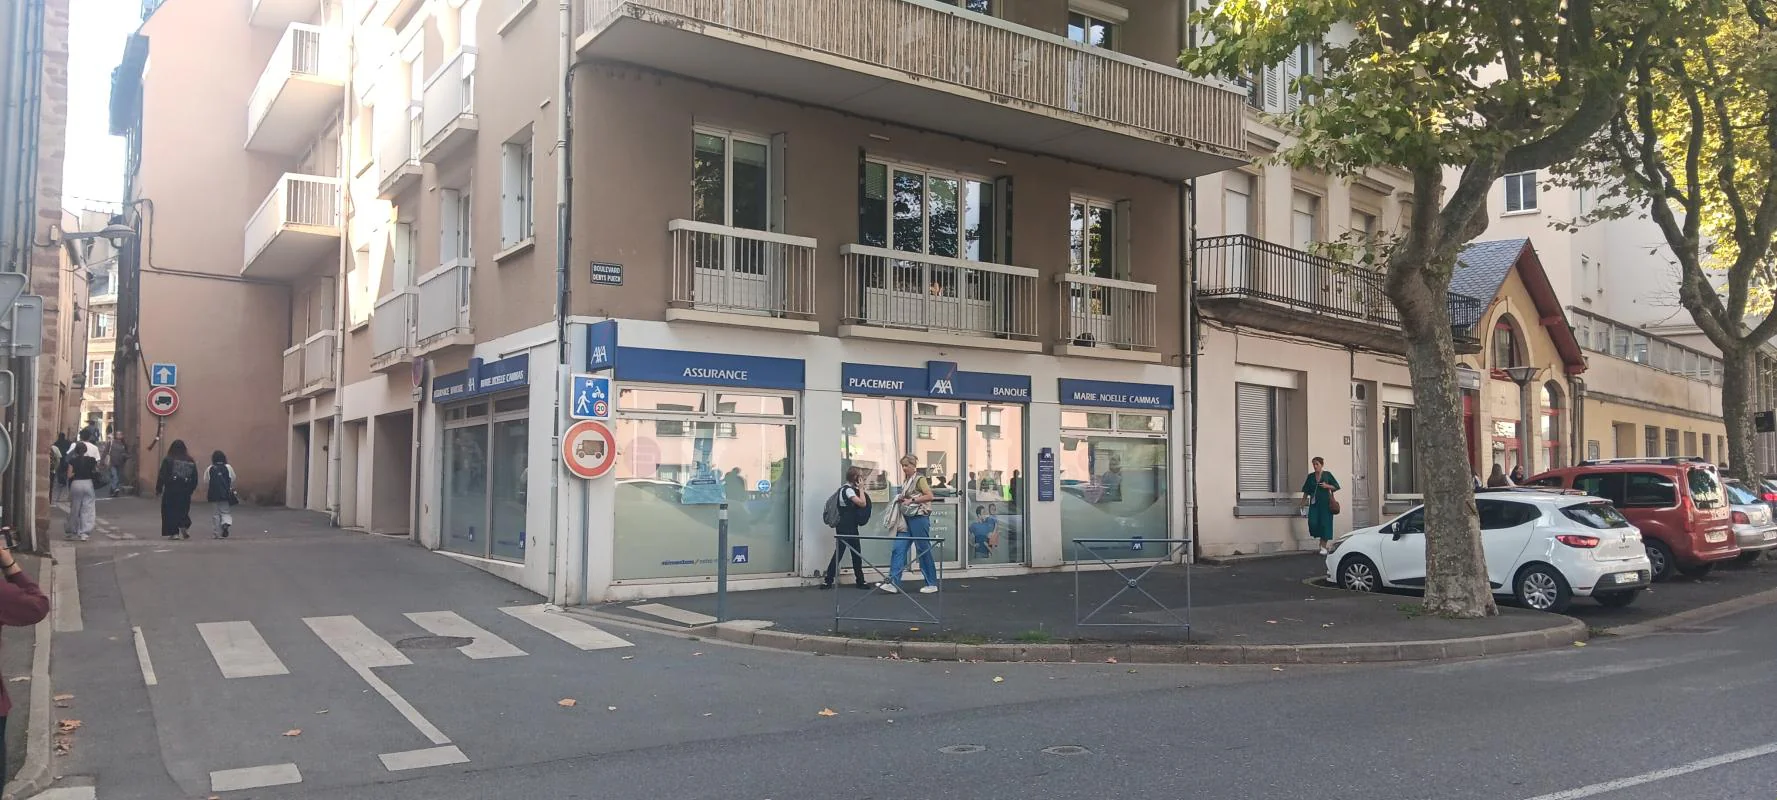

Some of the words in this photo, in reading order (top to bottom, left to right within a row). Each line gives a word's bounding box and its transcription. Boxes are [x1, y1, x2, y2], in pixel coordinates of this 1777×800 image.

[593, 264, 621, 274] BOULEVARD
[591, 345, 607, 364] AXA
[683, 367, 748, 381] ASSURANCE
[849, 377, 904, 390] PLACEMENT
[929, 379, 954, 395] AXA
[993, 387, 1028, 397] BANQUE
[1129, 395, 1160, 405] CAMMAS
